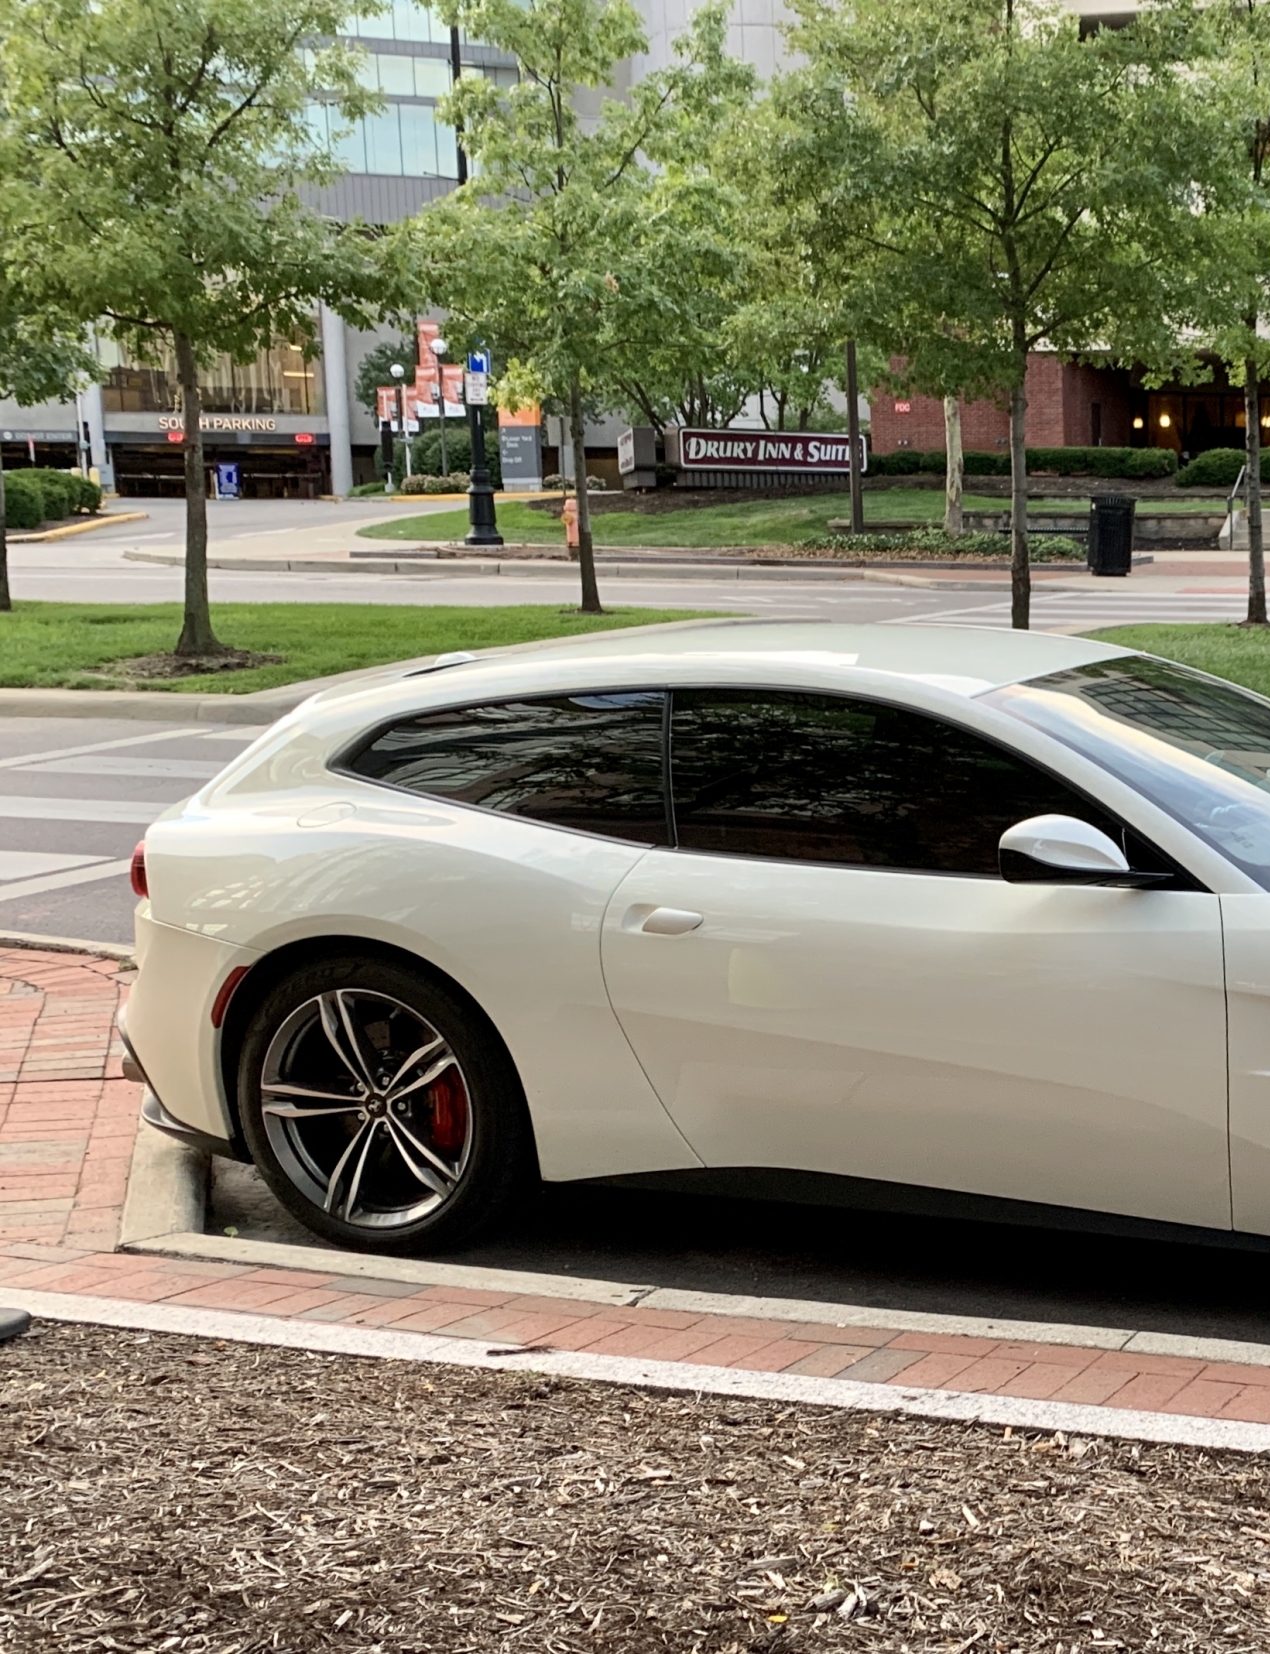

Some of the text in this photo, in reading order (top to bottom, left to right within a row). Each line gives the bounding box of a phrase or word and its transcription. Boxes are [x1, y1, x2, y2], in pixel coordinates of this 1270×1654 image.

[159, 417, 276, 431] SOUH PARKING
[686, 437, 756, 460] DRURY
[757, 439, 792, 461] INN
[793, 444, 804, 462] &
